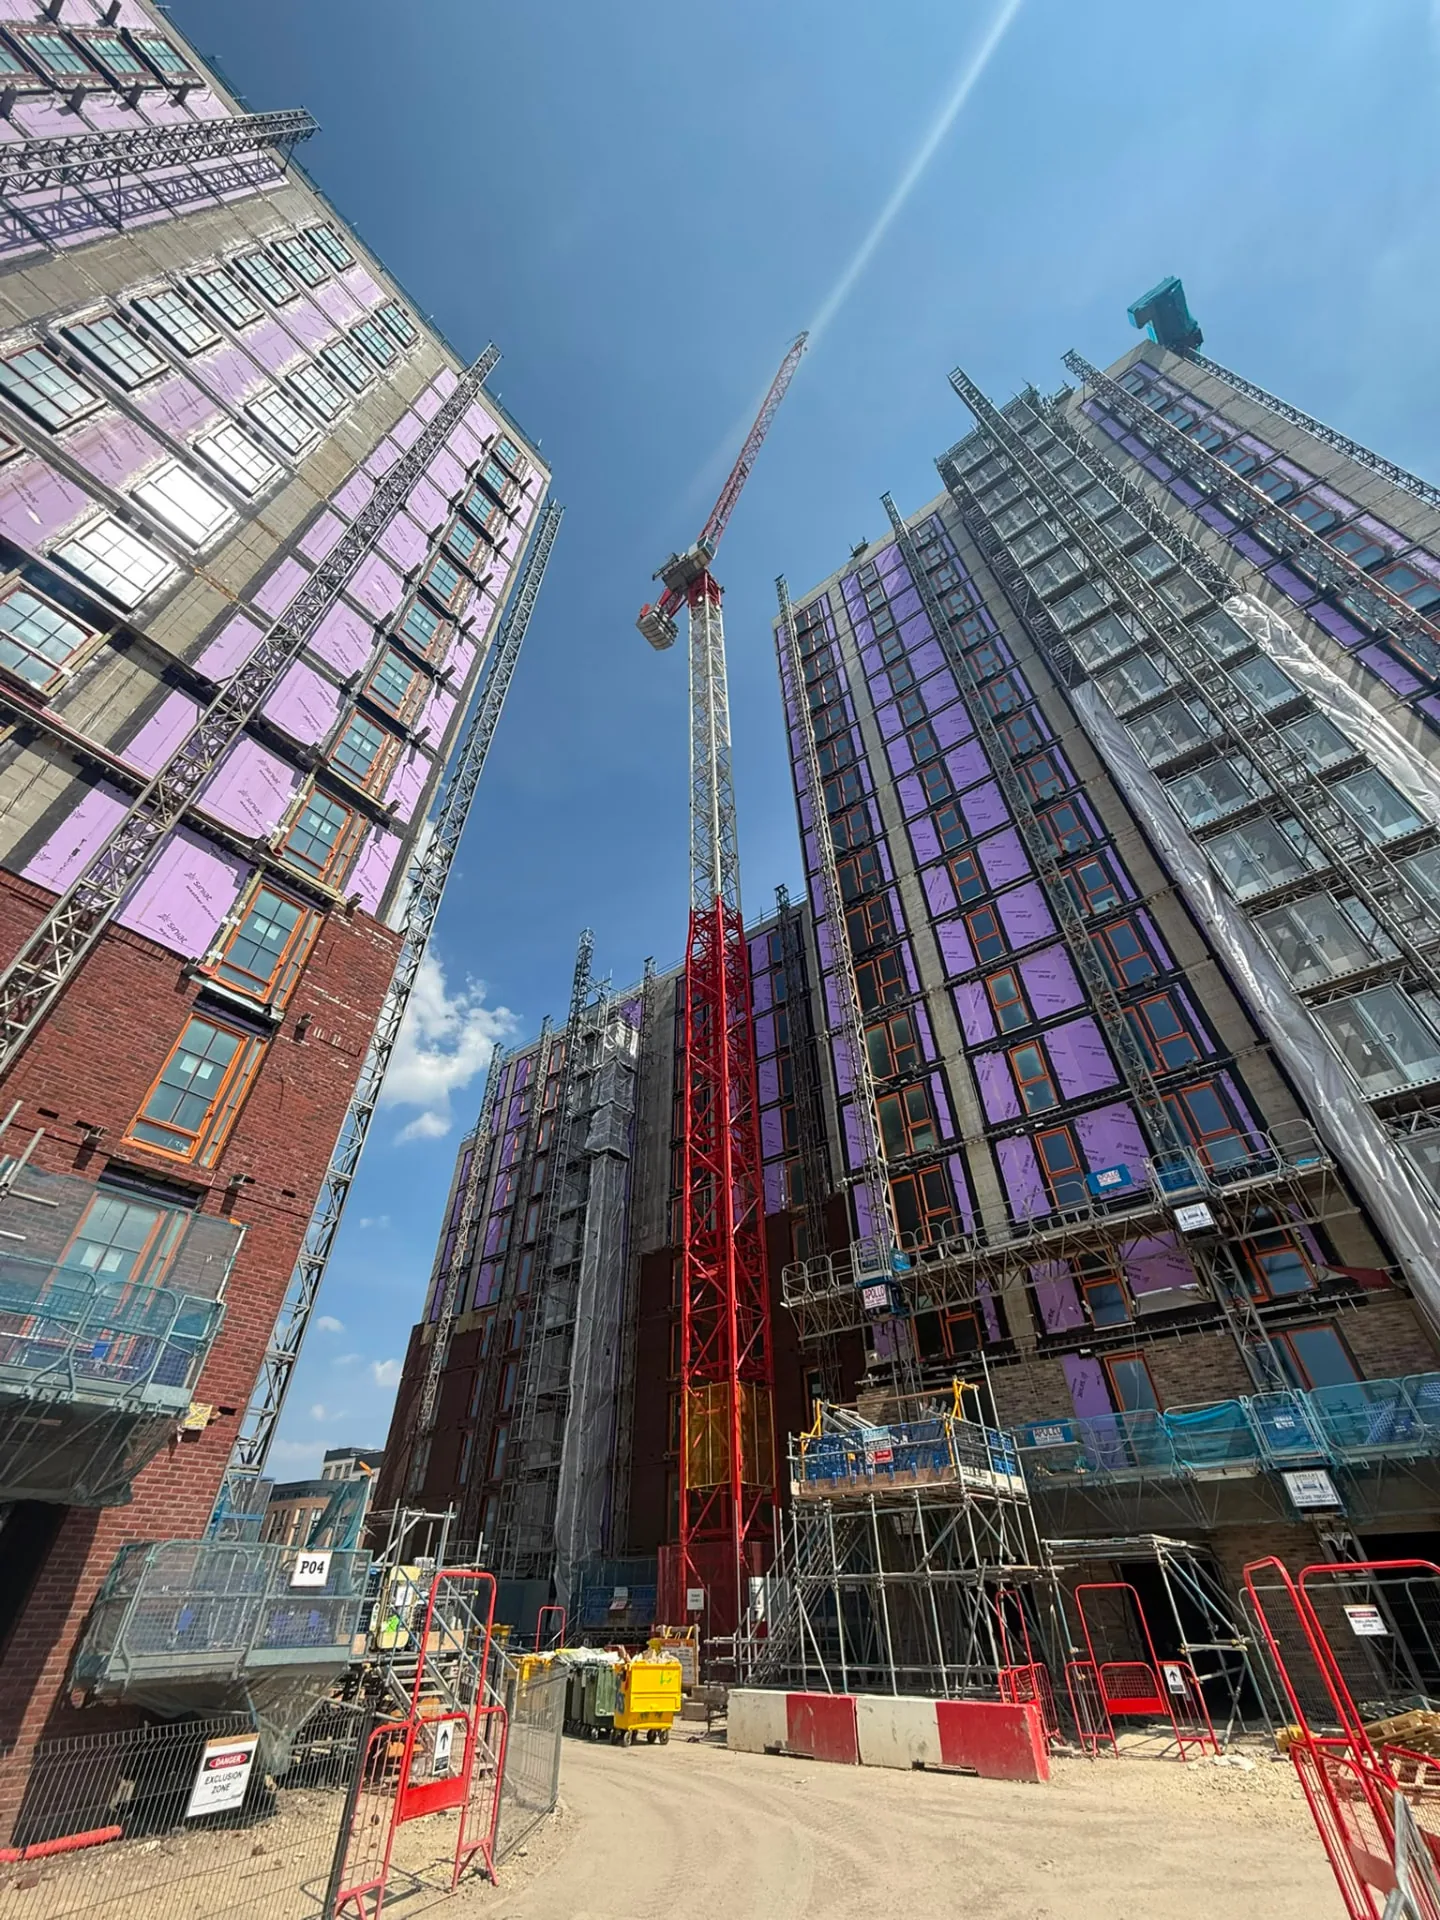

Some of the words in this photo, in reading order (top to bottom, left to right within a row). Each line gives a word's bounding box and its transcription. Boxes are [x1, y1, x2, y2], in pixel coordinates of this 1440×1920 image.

[167, 924, 188, 944] siniat
[865, 1286, 886, 1299] APOLLO
[299, 1560, 325, 1574] P04
[215, 1754, 241, 1766] DANGER
[205, 1771, 243, 1785] EXCLUSION
[211, 1783, 231, 1794] ZONE
